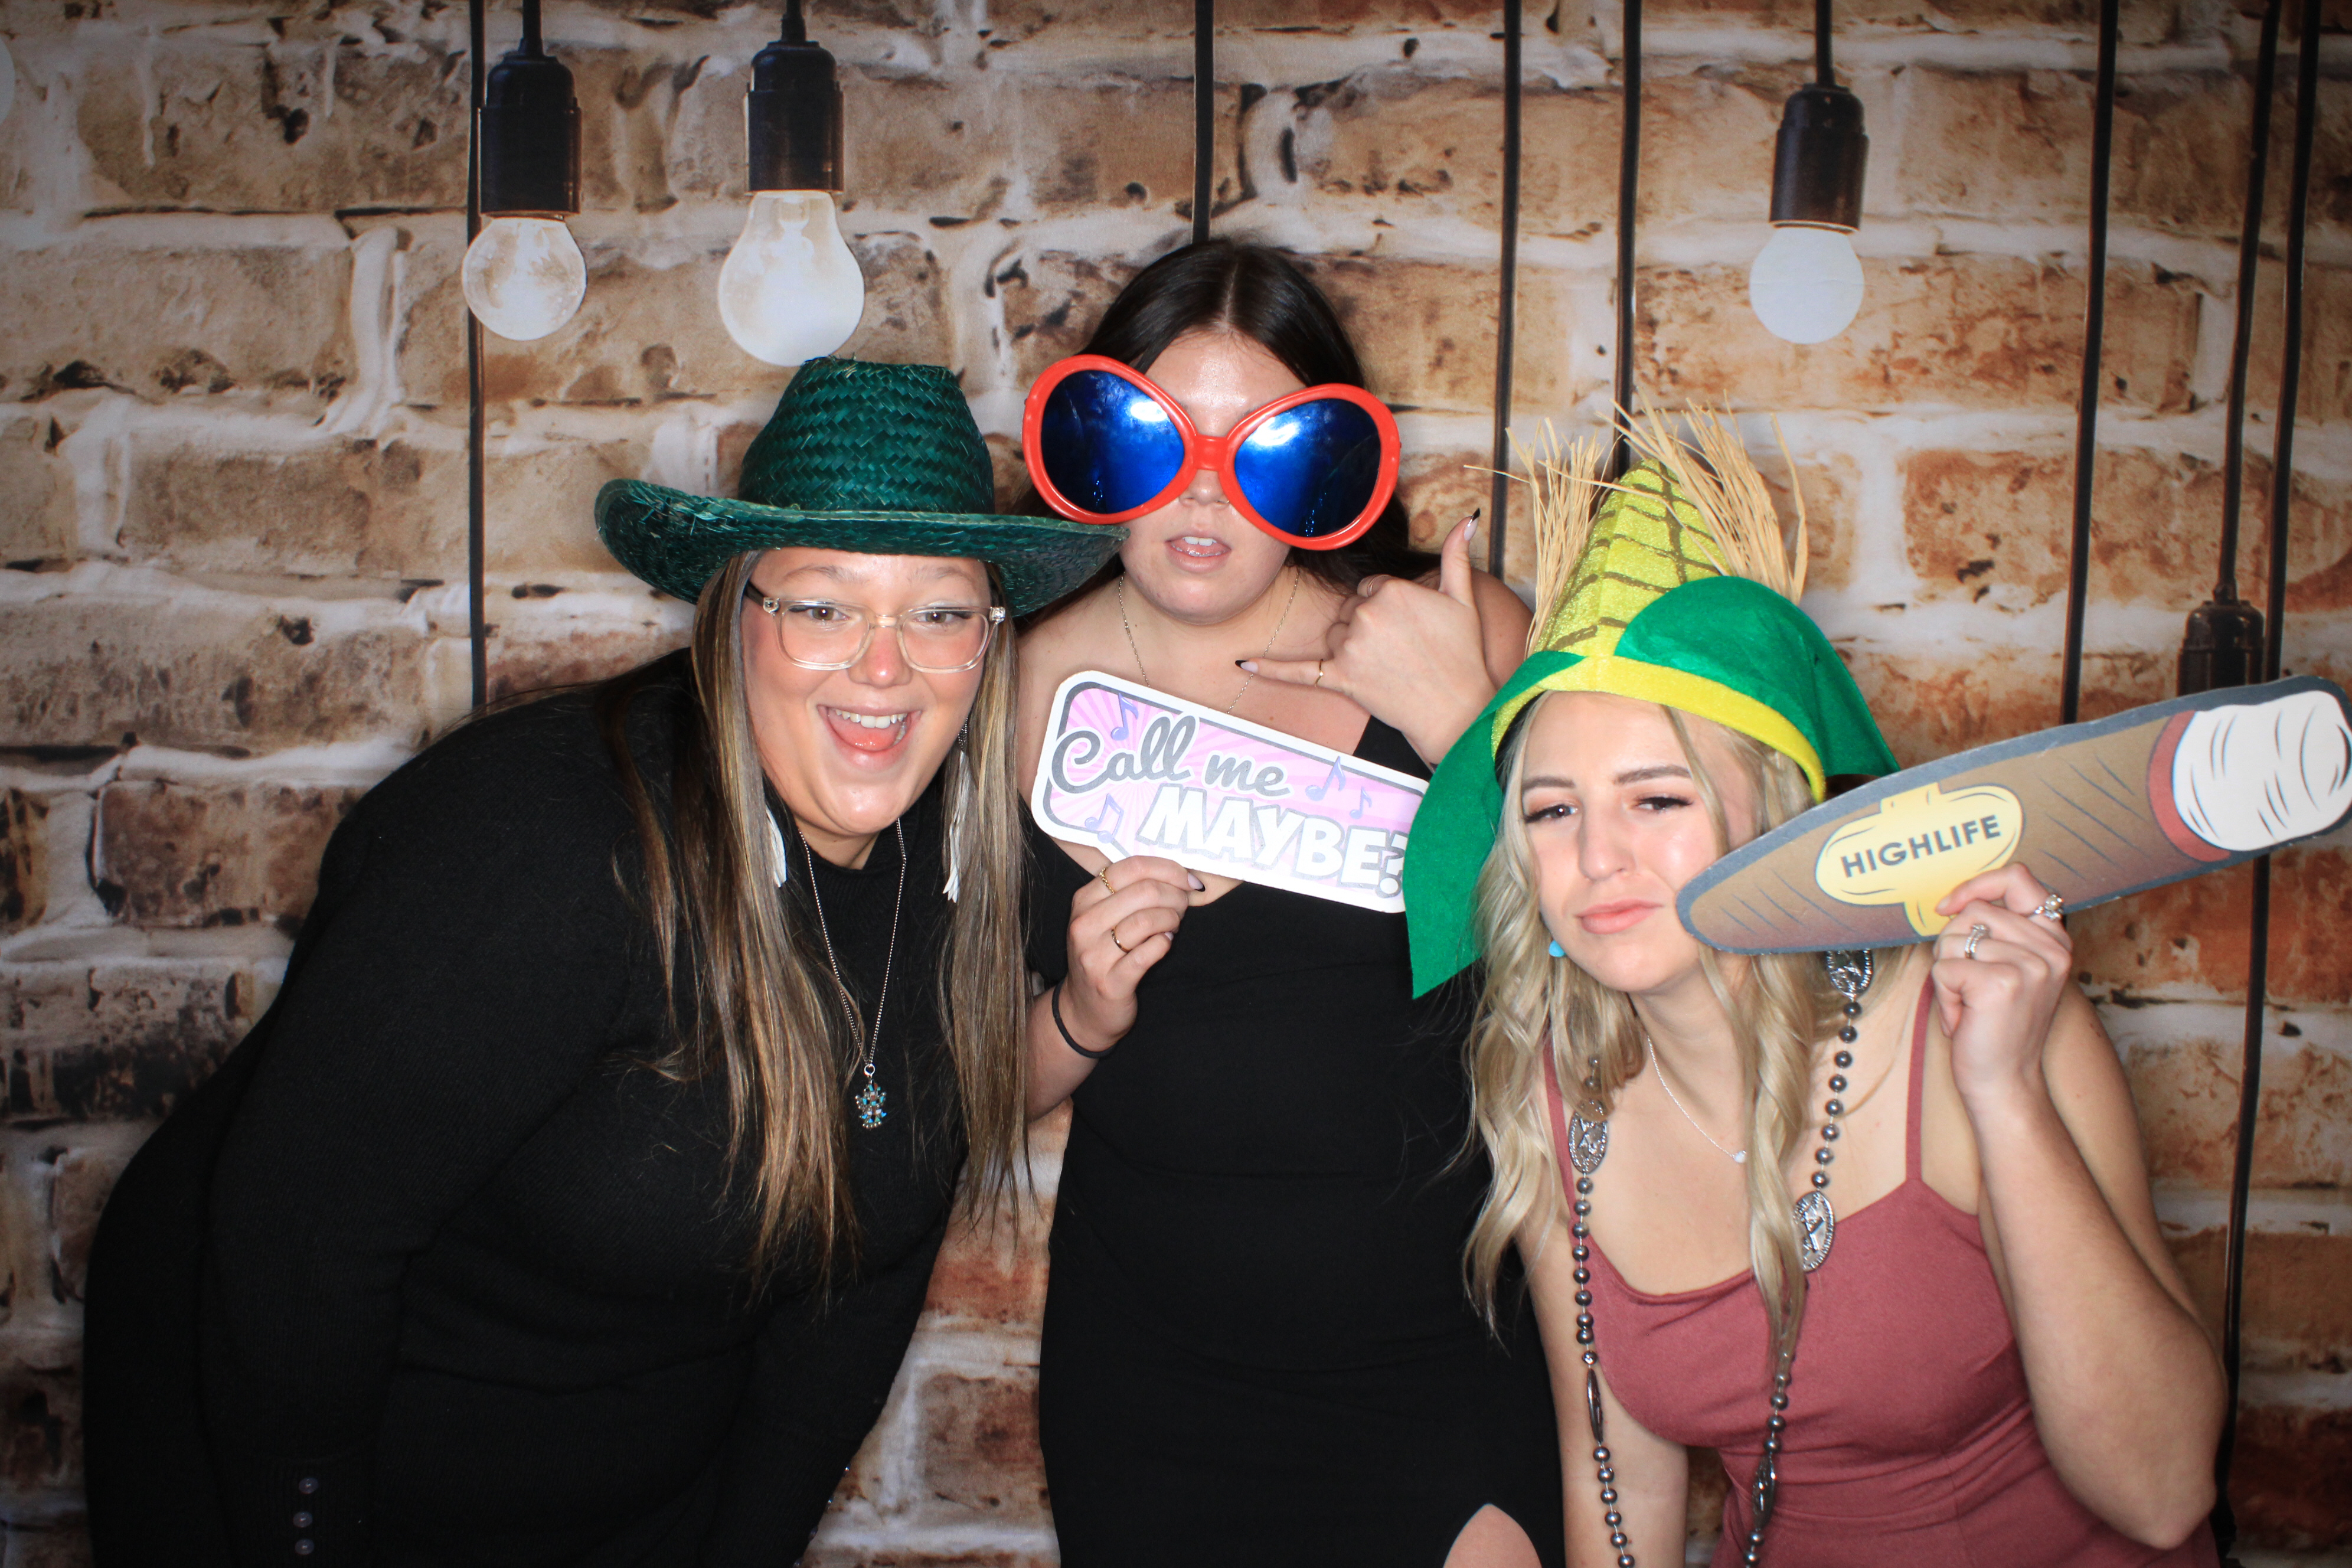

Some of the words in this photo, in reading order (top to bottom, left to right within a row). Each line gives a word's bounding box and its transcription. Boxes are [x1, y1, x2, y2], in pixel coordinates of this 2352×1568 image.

[1052, 716, 1196, 794] Call
[1204, 754, 1291, 796] me
[1840, 814, 2002, 878] HIGHLIFE
